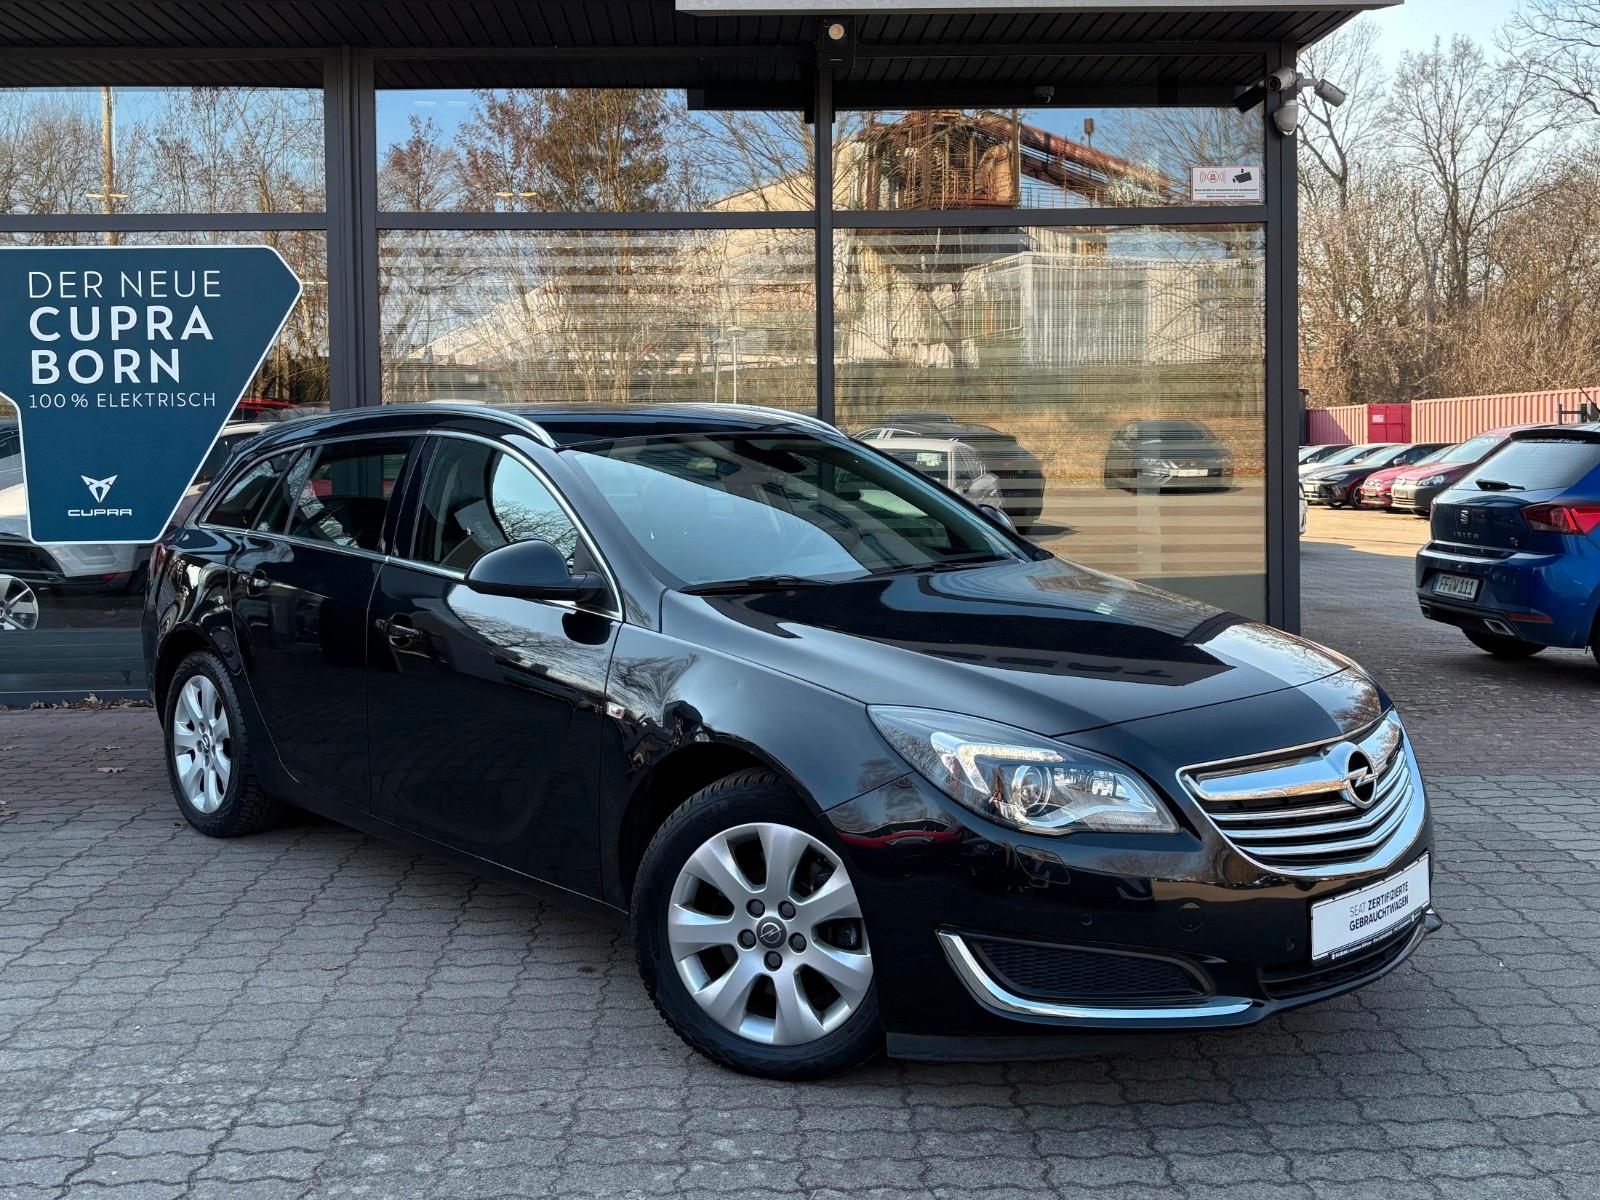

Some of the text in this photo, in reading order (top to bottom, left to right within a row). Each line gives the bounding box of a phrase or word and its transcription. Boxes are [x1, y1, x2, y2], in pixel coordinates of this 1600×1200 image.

[28, 270, 222, 299] DER NEUE
[29, 304, 214, 342] CUPRA
[31, 348, 180, 385] BORN
[97, 391, 216, 408] ELEKTRISCH
[67, 508, 133, 517] CUPRA
[1349, 881, 1409, 918] SEAT ZERTIFIZIERTE
[1349, 895, 1409, 931] GEBRAUCHTWAGEN
